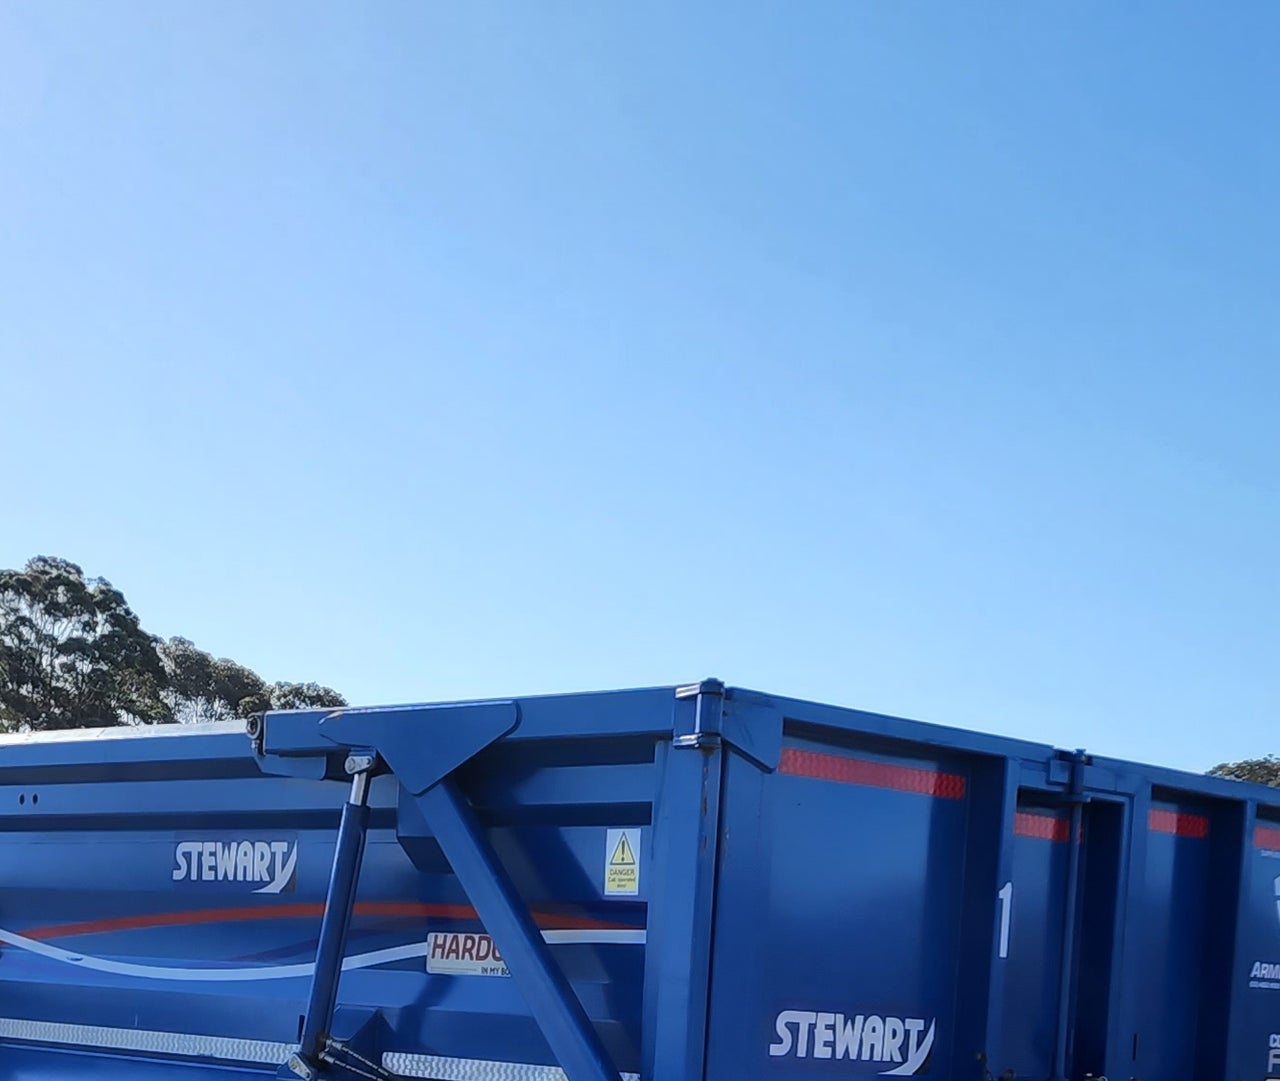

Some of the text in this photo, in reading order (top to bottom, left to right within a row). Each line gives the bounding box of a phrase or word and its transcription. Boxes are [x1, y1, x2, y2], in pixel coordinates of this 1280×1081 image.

[172, 840, 298, 894] STEWART
[998, 882, 1013, 958] 1
[431, 934, 503, 962] HARD
[490, 967, 499, 975] MY
[769, 1010, 936, 1076] STEWART
